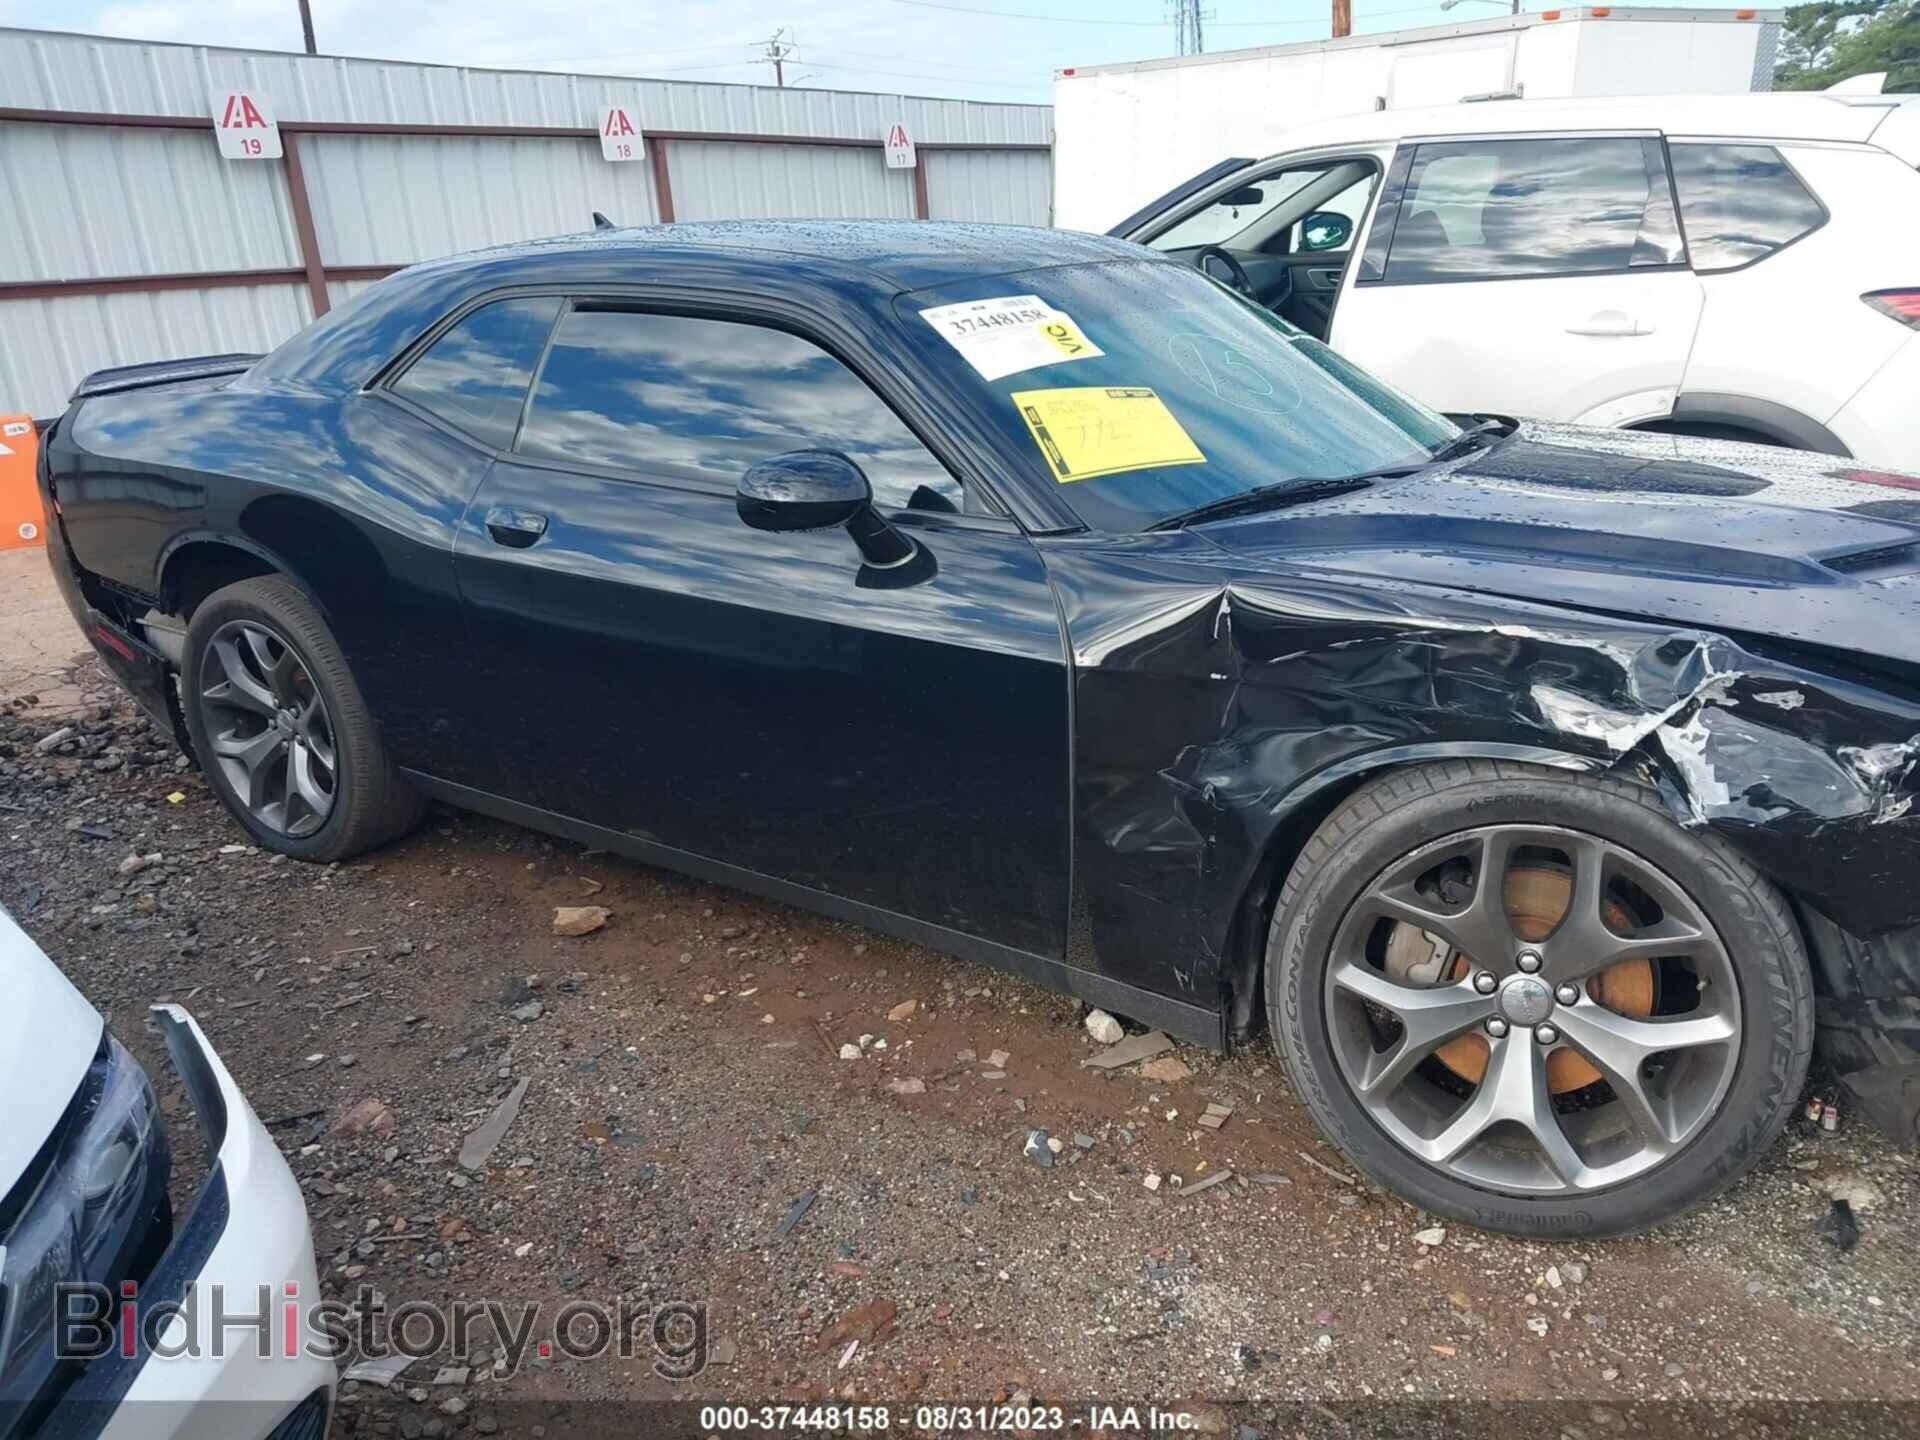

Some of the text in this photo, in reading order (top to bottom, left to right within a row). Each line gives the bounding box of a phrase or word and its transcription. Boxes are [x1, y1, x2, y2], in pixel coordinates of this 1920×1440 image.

[241, 138, 262, 154] 19
[617, 144, 632, 158] 18
[897, 153, 906, 165] 17
[950, 309, 1048, 335] 37448158
